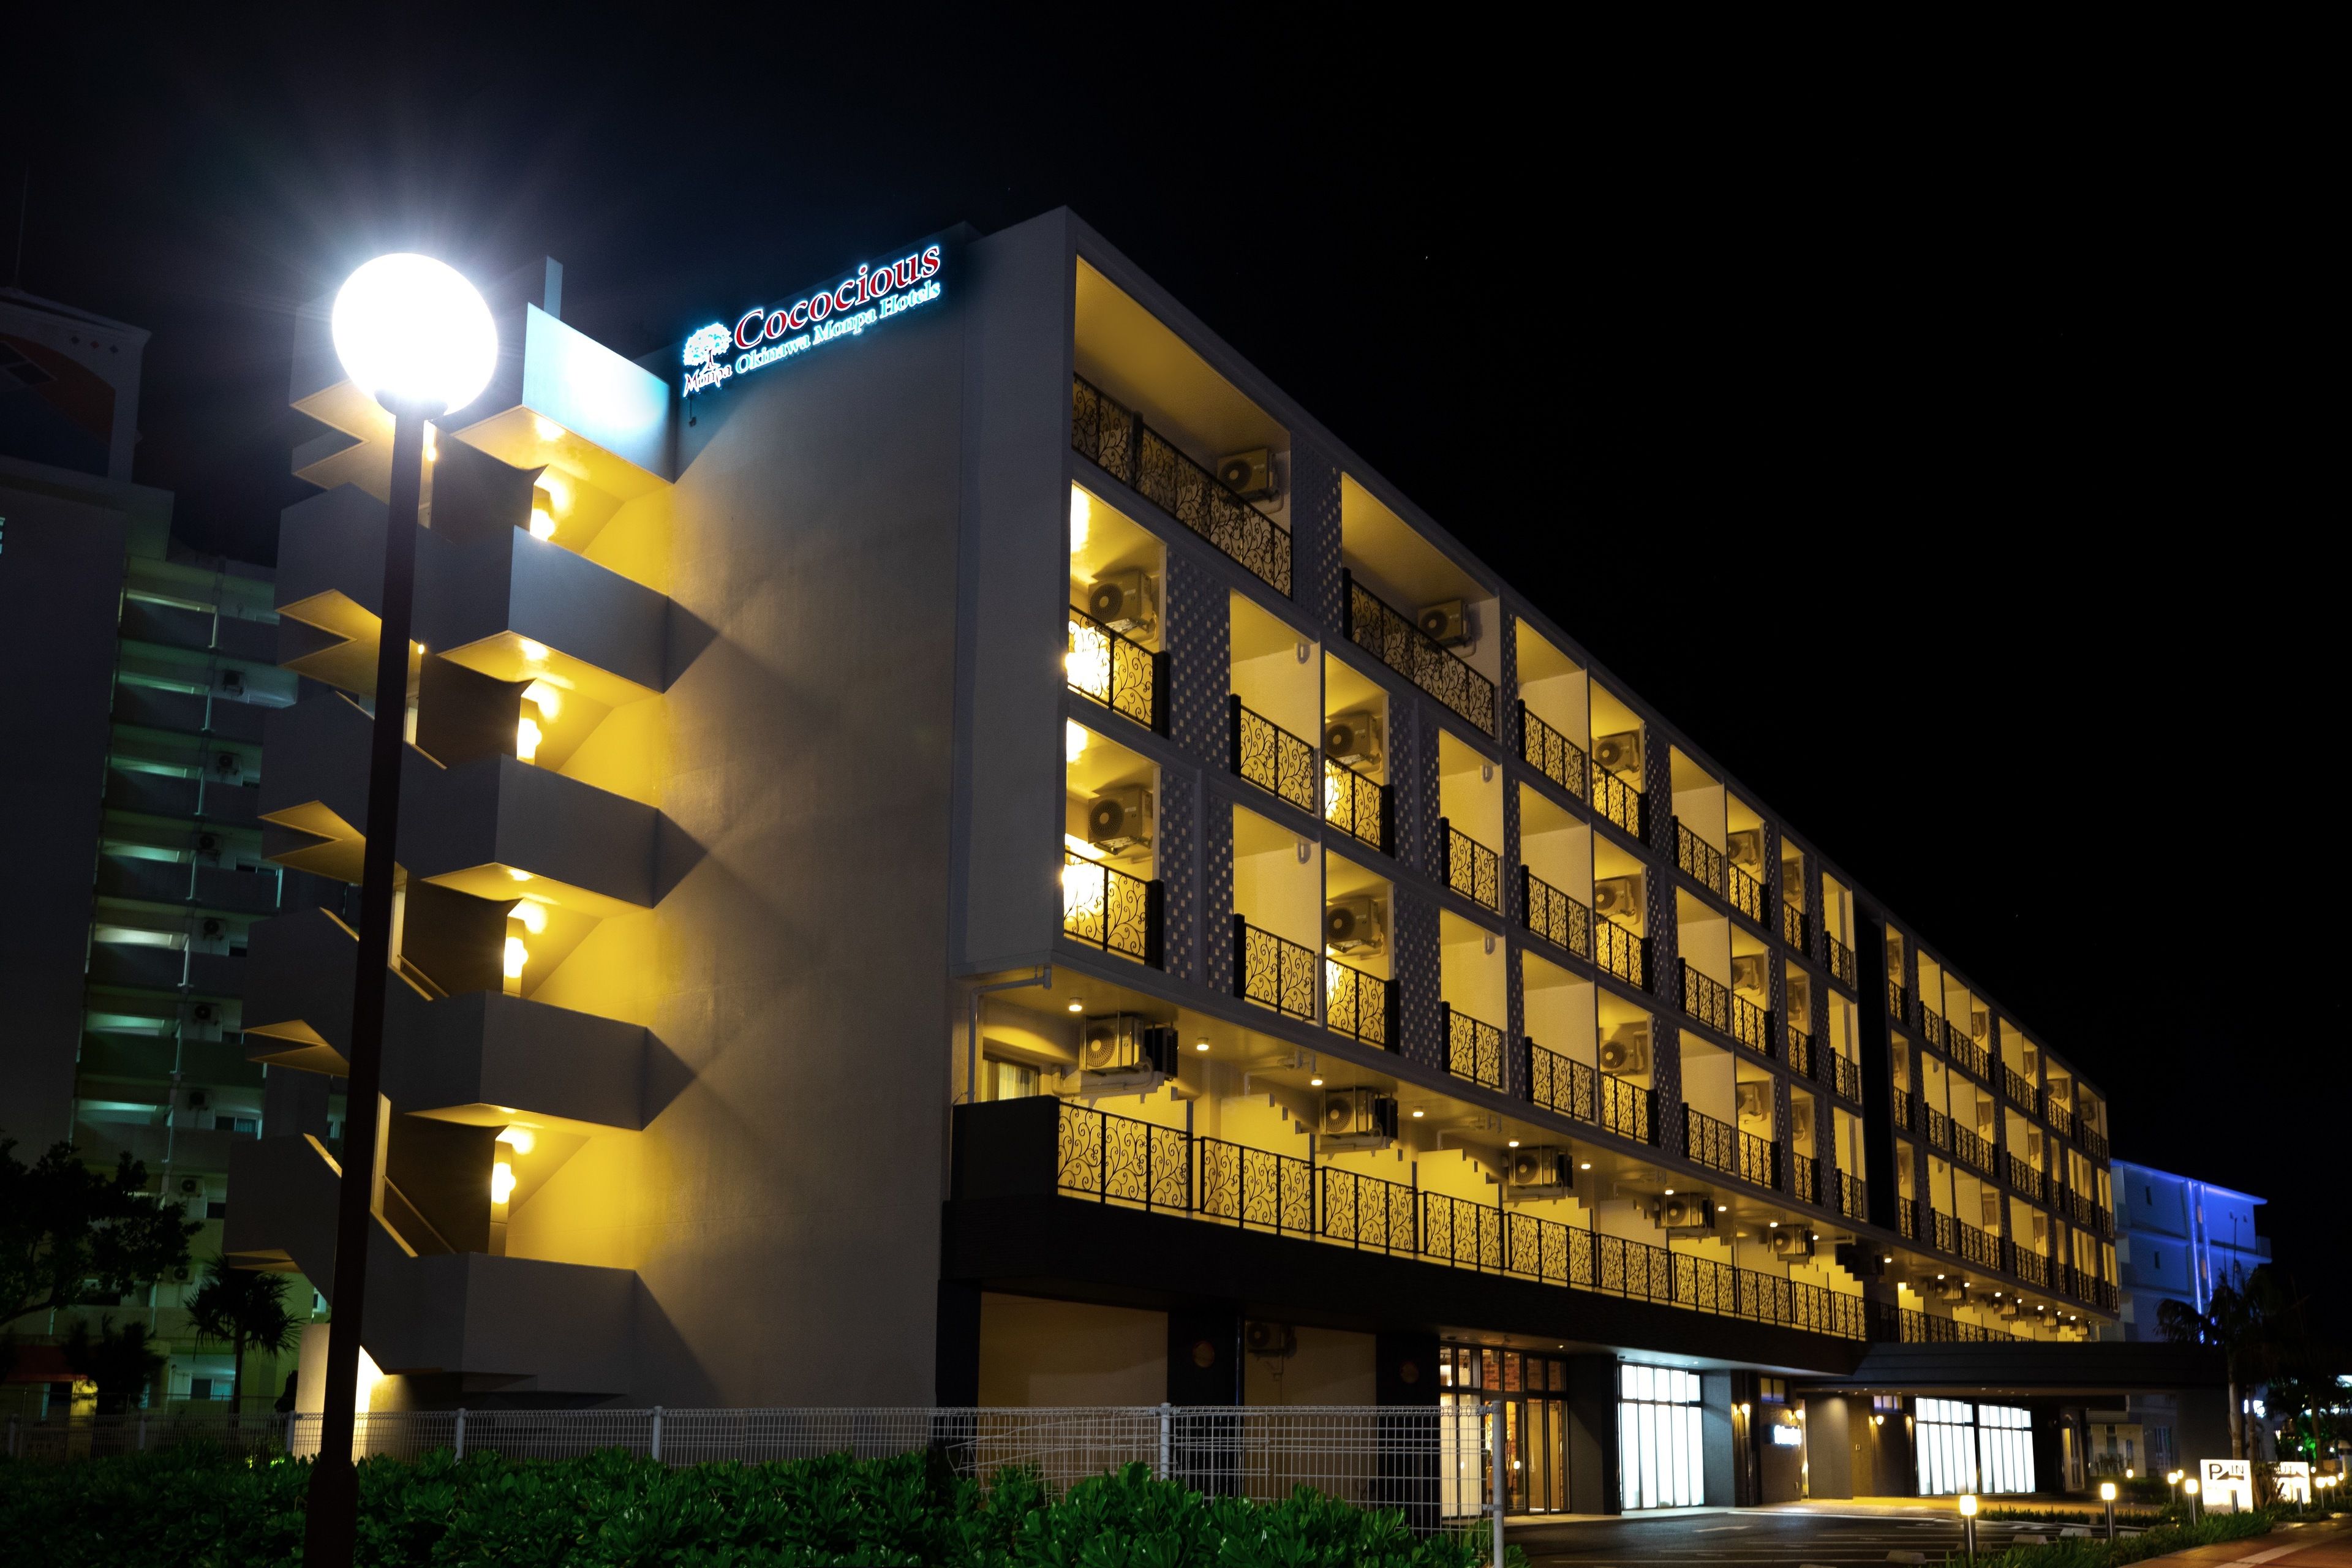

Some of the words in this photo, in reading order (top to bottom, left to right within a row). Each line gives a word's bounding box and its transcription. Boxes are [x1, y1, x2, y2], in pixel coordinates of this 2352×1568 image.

[734, 245, 941, 350] Cococious
[735, 334, 810, 374] Okinawa
[814, 309, 877, 345] Monpa
[879, 280, 941, 318] Hotels
[2209, 1463, 2223, 1480] P
[2231, 1464, 2244, 1474] IN
